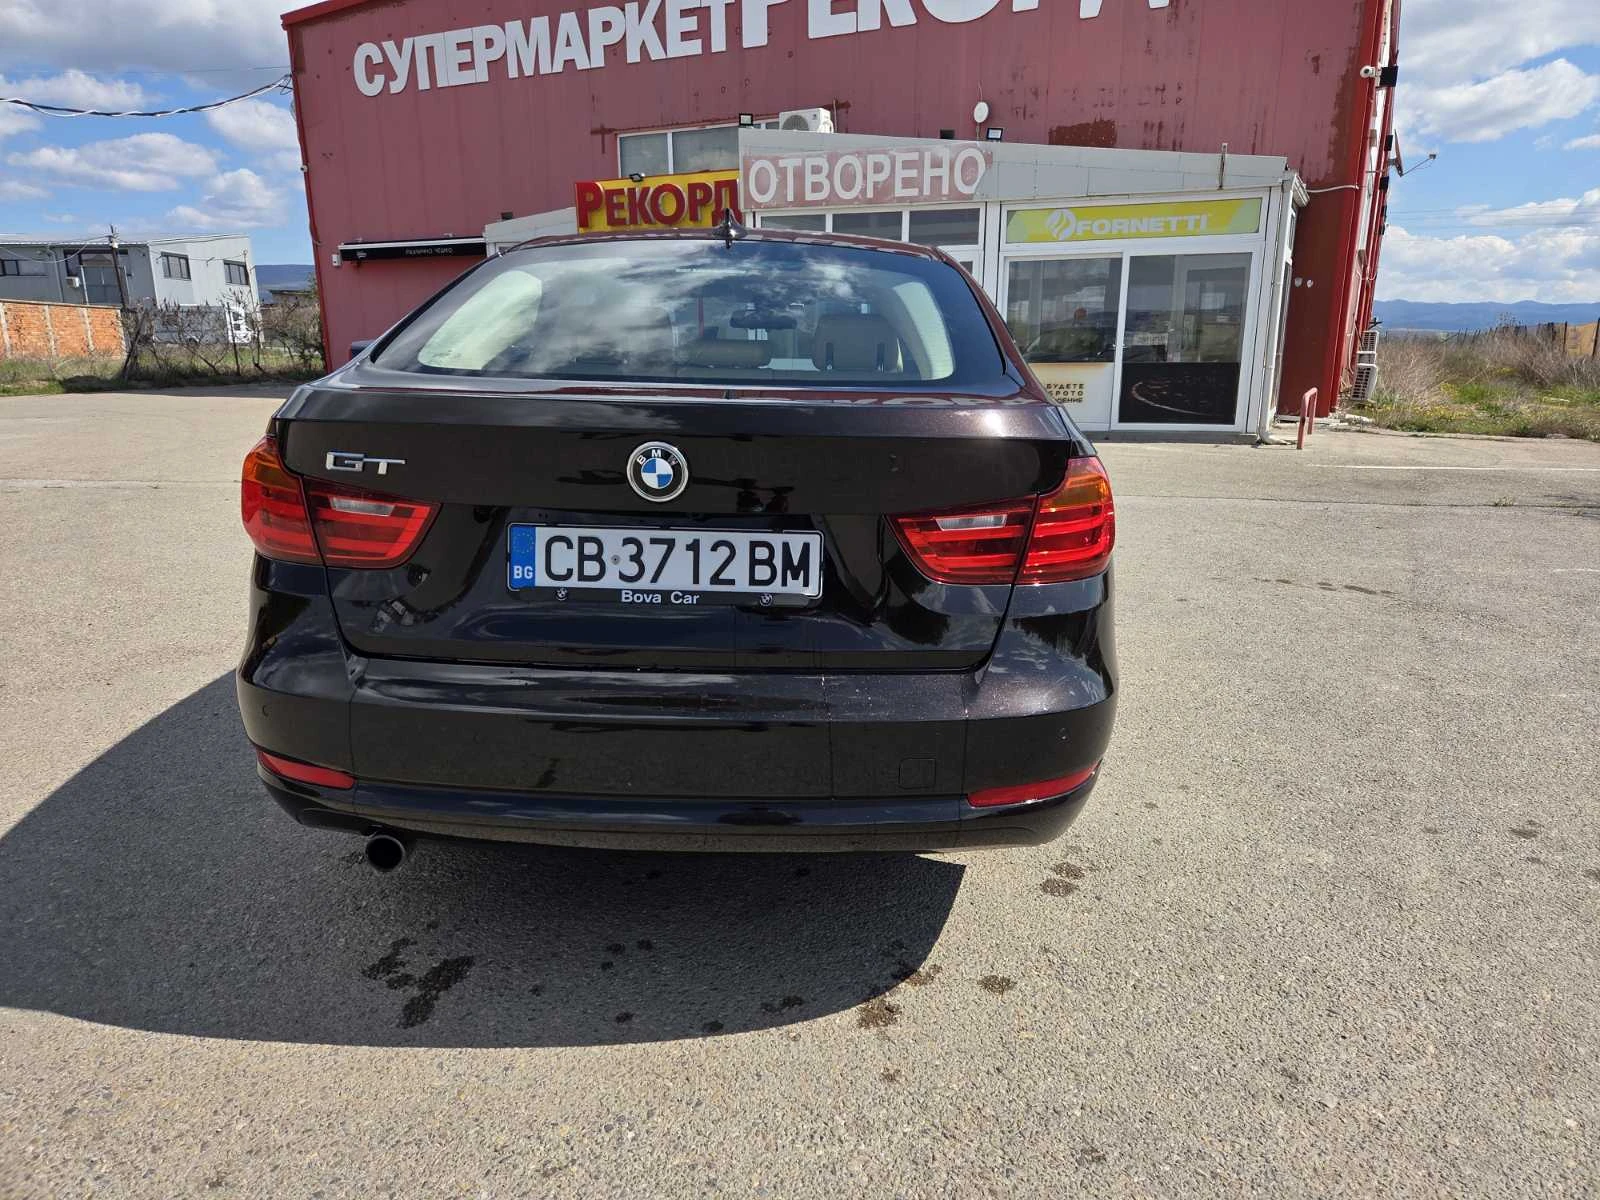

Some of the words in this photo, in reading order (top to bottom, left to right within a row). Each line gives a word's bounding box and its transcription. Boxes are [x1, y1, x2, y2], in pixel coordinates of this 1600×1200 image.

[353, 0, 735, 97] СУПЕРМАРКЕТ
[748, 146, 987, 204] ОТВОРЕНО
[576, 179, 744, 229] РЕКОРД
[1075, 213, 1209, 236] FORNETTI
[326, 450, 406, 475] GT
[636, 449, 679, 466] BMW
[513, 565, 534, 580] BG
[617, 537, 737, 586] 3712
[620, 590, 662, 604] Bova
[670, 591, 701, 605] Car
